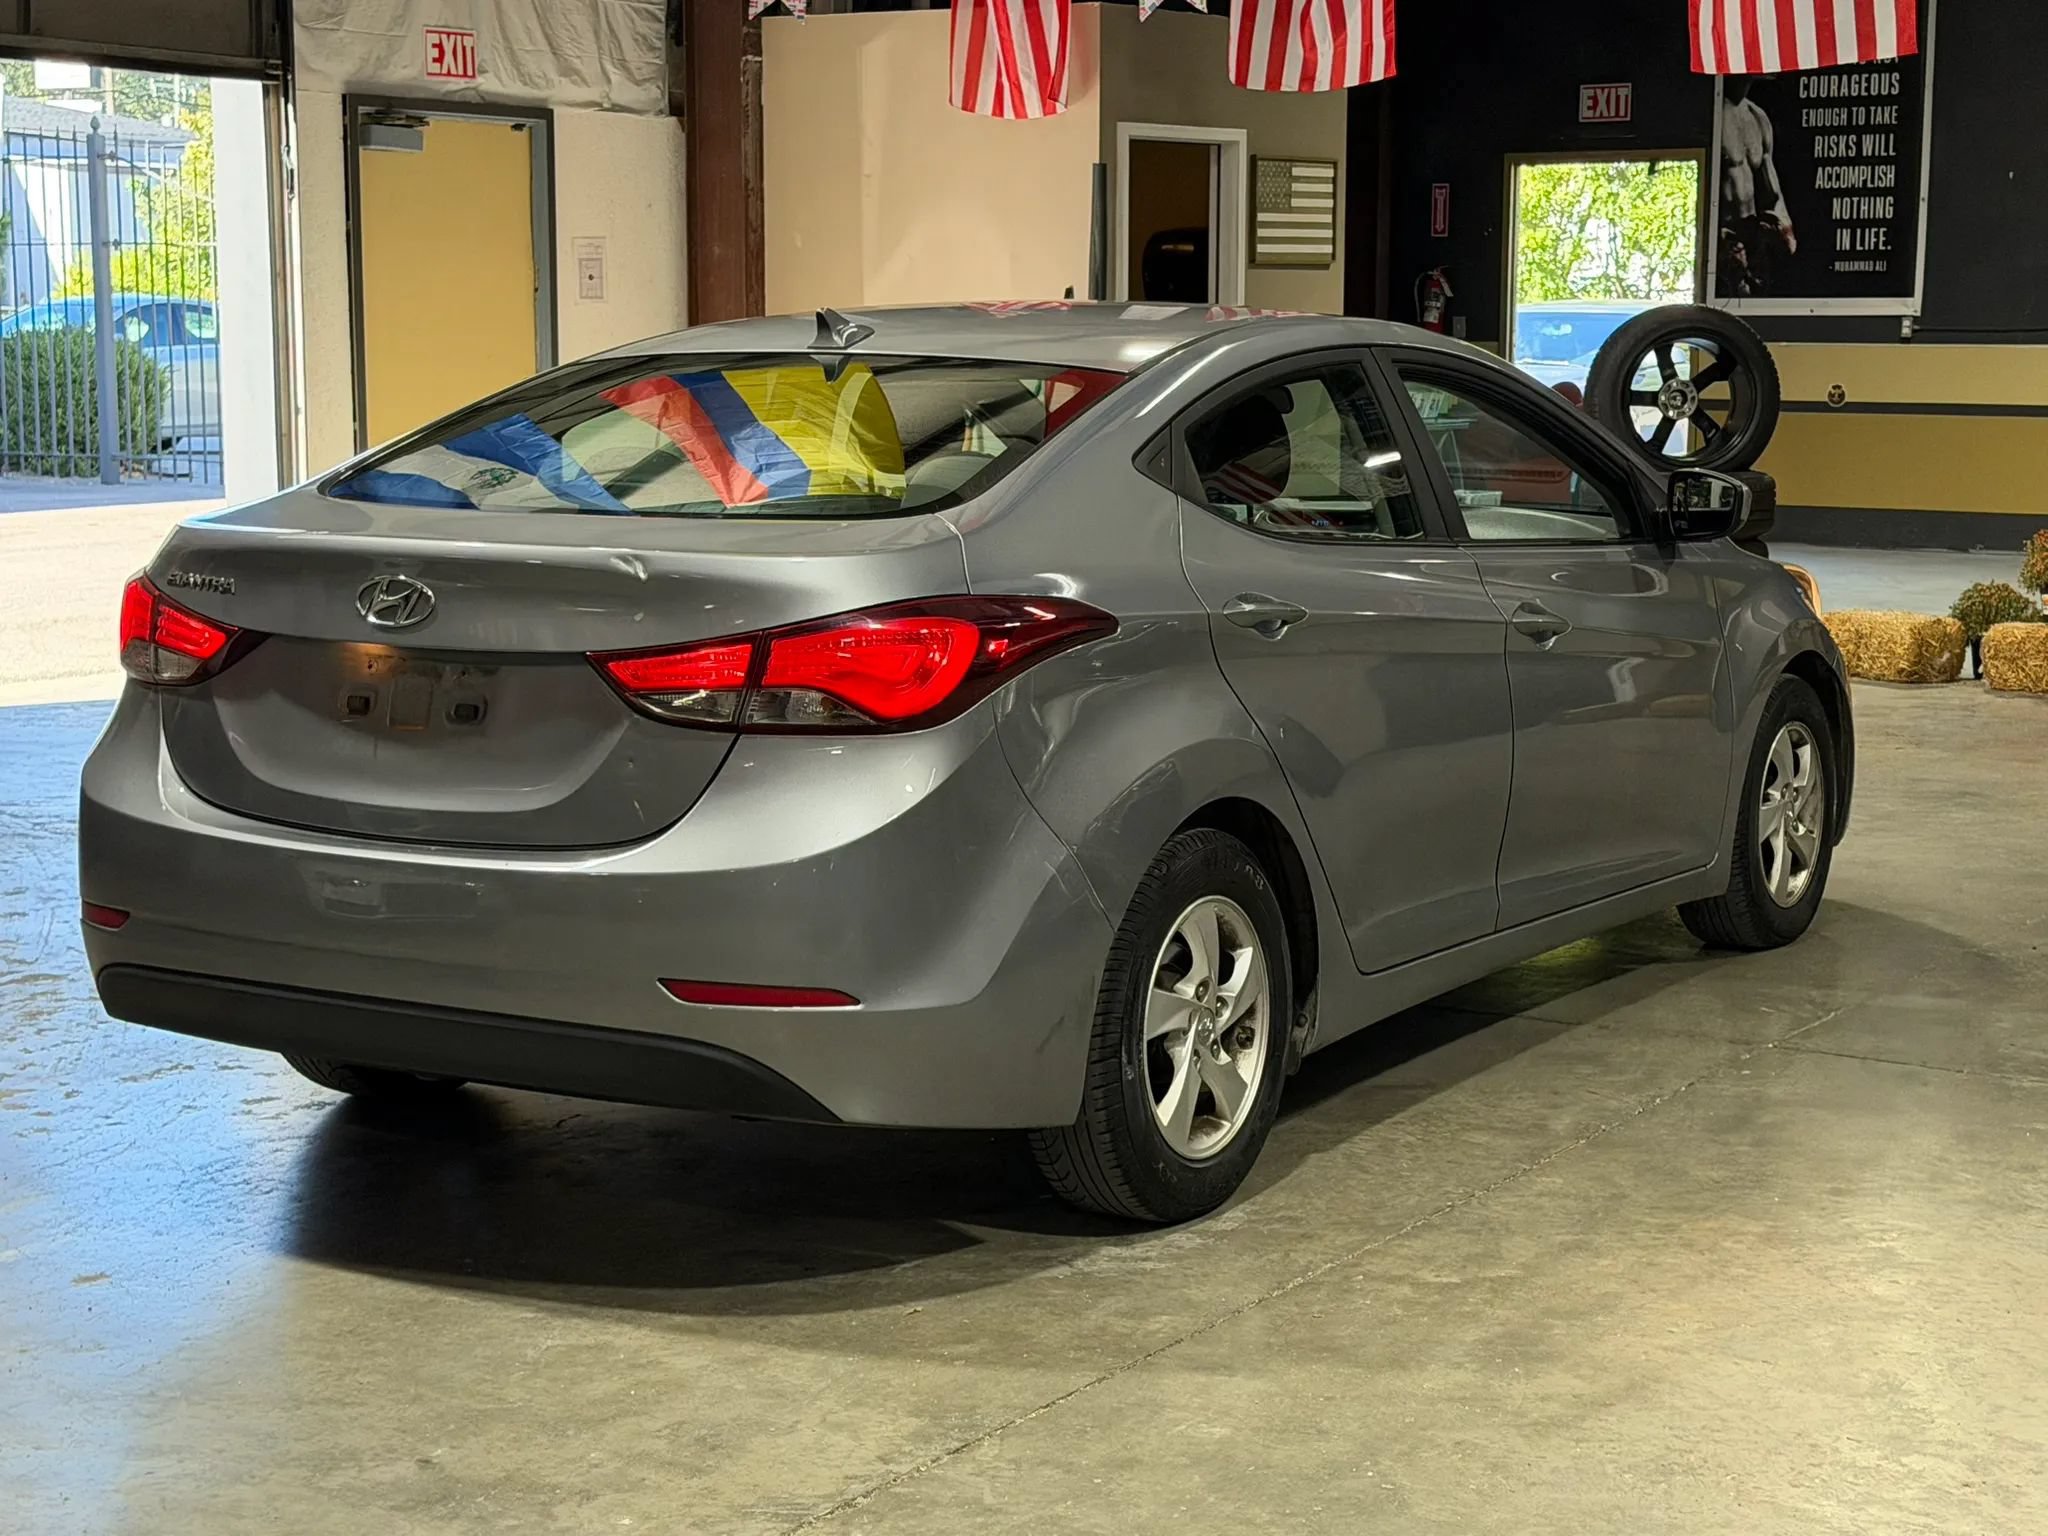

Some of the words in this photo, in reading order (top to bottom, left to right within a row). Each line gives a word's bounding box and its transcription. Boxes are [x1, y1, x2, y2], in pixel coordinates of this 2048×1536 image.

[426, 33, 474, 76] EXIT
[1799, 72, 1900, 98] COURAGEOUS
[1583, 87, 1630, 118] EXIT
[1802, 107, 1848, 128] ENOUGH
[1851, 106, 1866, 126] TO
[1869, 105, 1899, 125] TAKE
[1814, 134, 1857, 158] RISKS
[1861, 133, 1897, 157] WILL
[1814, 164, 1896, 190] ACCOMPLISH
[1832, 196, 1894, 220] NOTHING
[1836, 228, 1851, 251] IN
[1856, 227, 1892, 251] LIFE.
[1875, 260, 1887, 272] ALI
